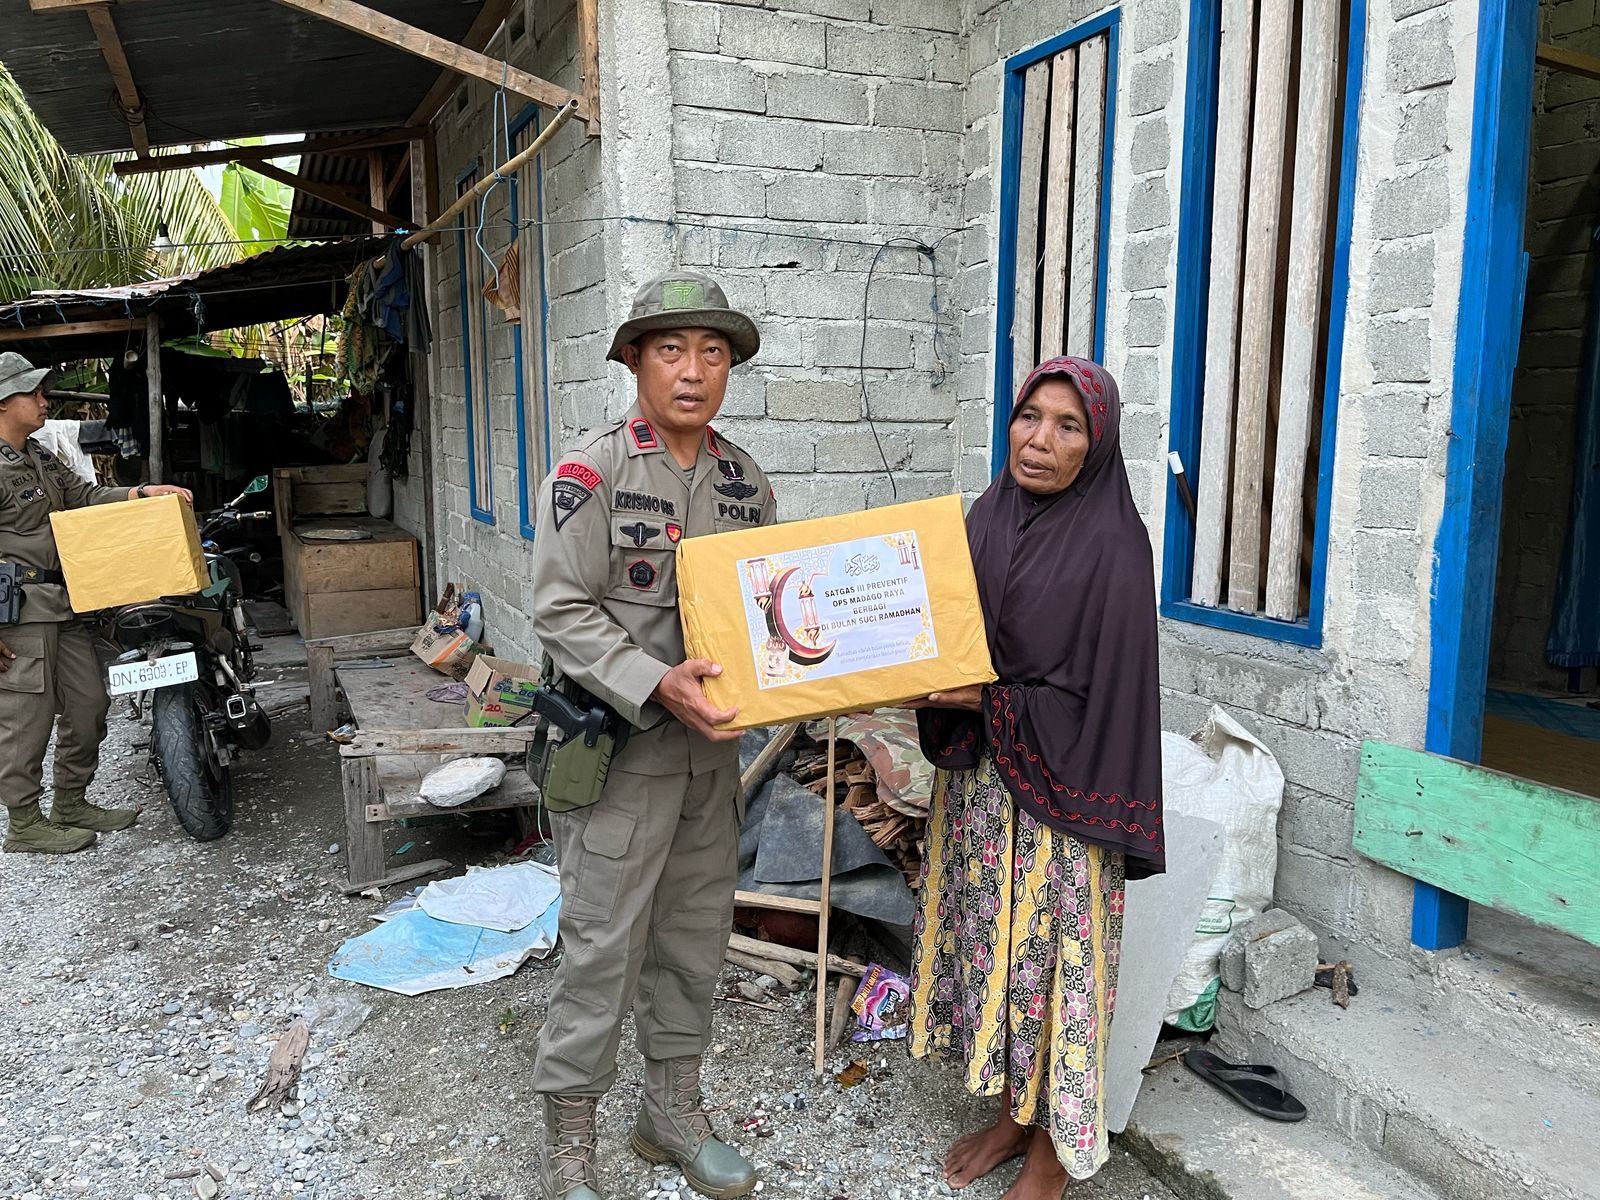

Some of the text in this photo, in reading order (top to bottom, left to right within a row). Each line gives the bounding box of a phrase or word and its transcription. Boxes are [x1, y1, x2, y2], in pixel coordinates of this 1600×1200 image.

[559, 464, 597, 485] PELOPOR
[615, 490, 660, 512] KRISNO
[825, 586, 855, 598] SATGAS
[866, 576, 908, 591] PREVENTIF
[832, 588, 905, 608] OPS MADAGO RAYA
[821, 606, 921, 631] DI BULAN SUCI RAMADHAN
[853, 602, 887, 615] BERBAGI
[112, 671, 132, 687] DN
[175, 660, 188, 675] EP
